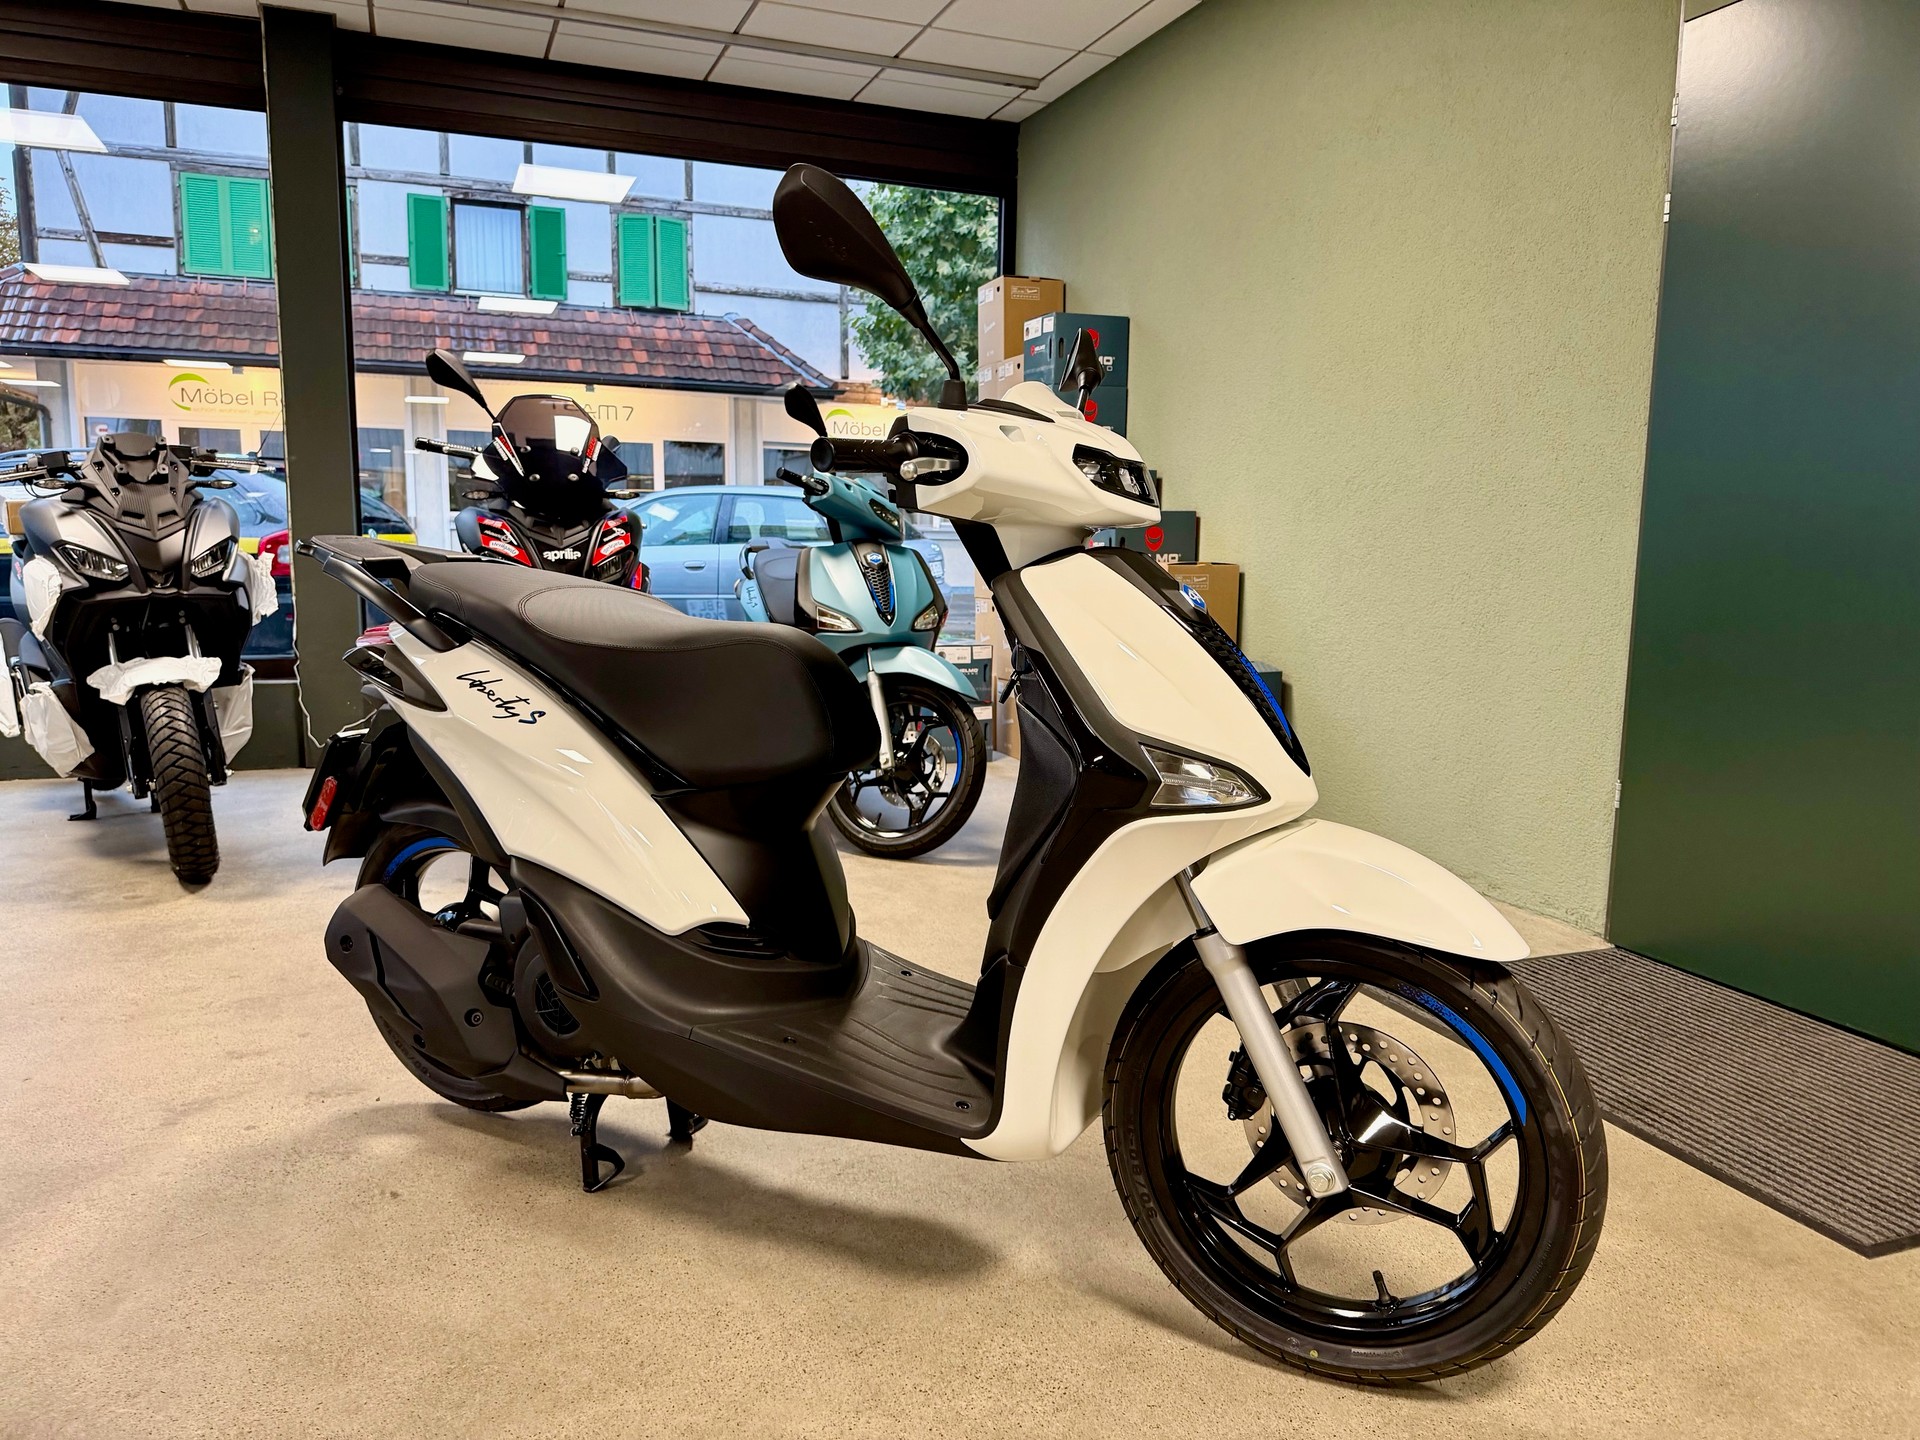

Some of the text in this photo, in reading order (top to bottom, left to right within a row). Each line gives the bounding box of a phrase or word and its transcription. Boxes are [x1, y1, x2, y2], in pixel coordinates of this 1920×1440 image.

[181, 386, 282, 407] Möbel R
[833, 421, 886, 437] Möbel
[542, 548, 582, 562] aprilia
